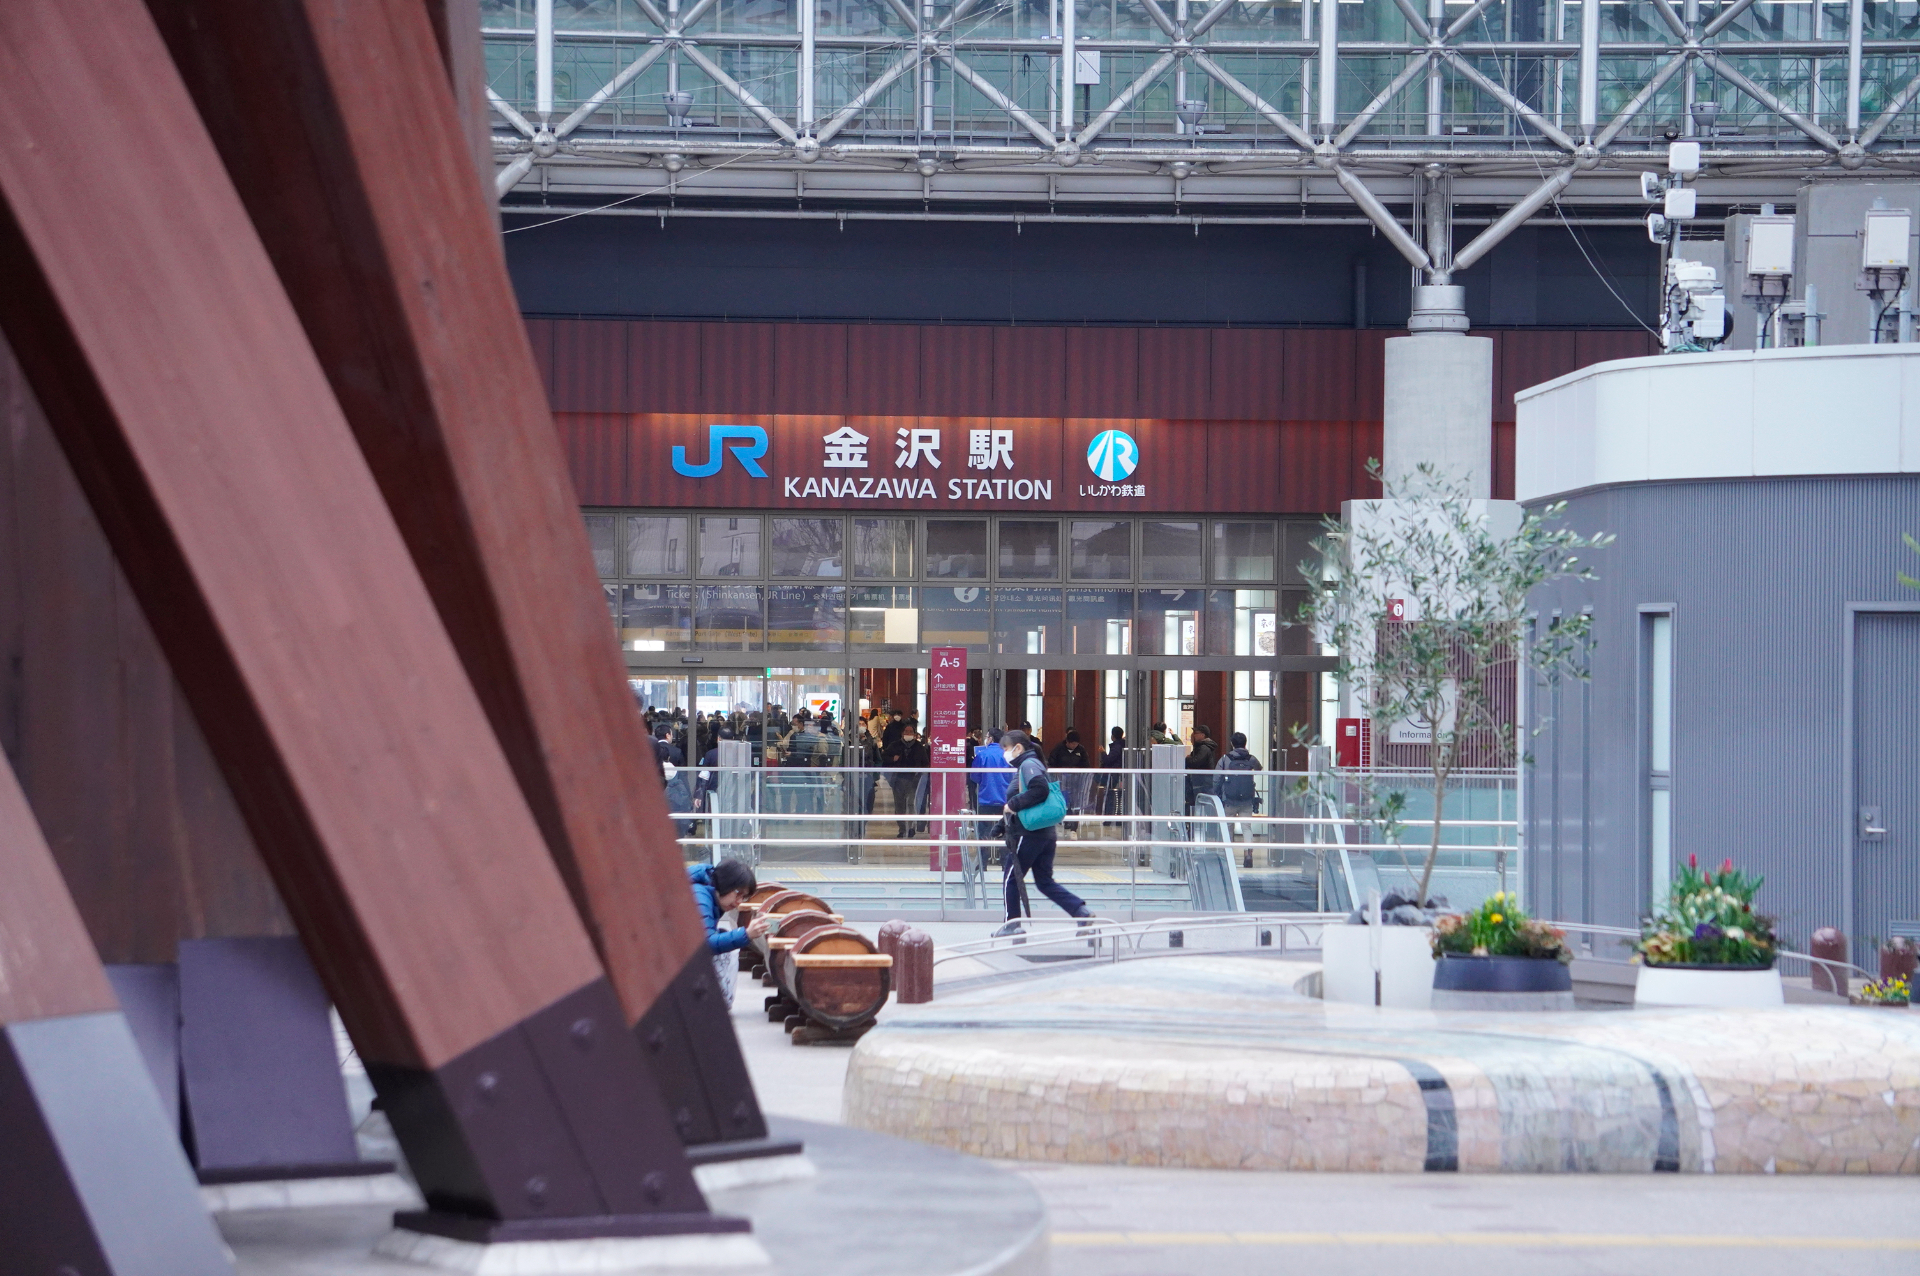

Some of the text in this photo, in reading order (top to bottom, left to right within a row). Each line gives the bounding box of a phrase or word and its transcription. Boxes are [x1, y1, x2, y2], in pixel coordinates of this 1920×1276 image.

[672, 425, 768, 477] JR
[823, 427, 1014, 470] 金沢駅
[785, 477, 1051, 500] KANAZAWA STATION
[1080, 485, 1145, 497] いしかわ鉄道
[666, 589, 698, 599] Tickes
[940, 657, 960, 668] A-5
[1399, 731, 1448, 739] Informaon
